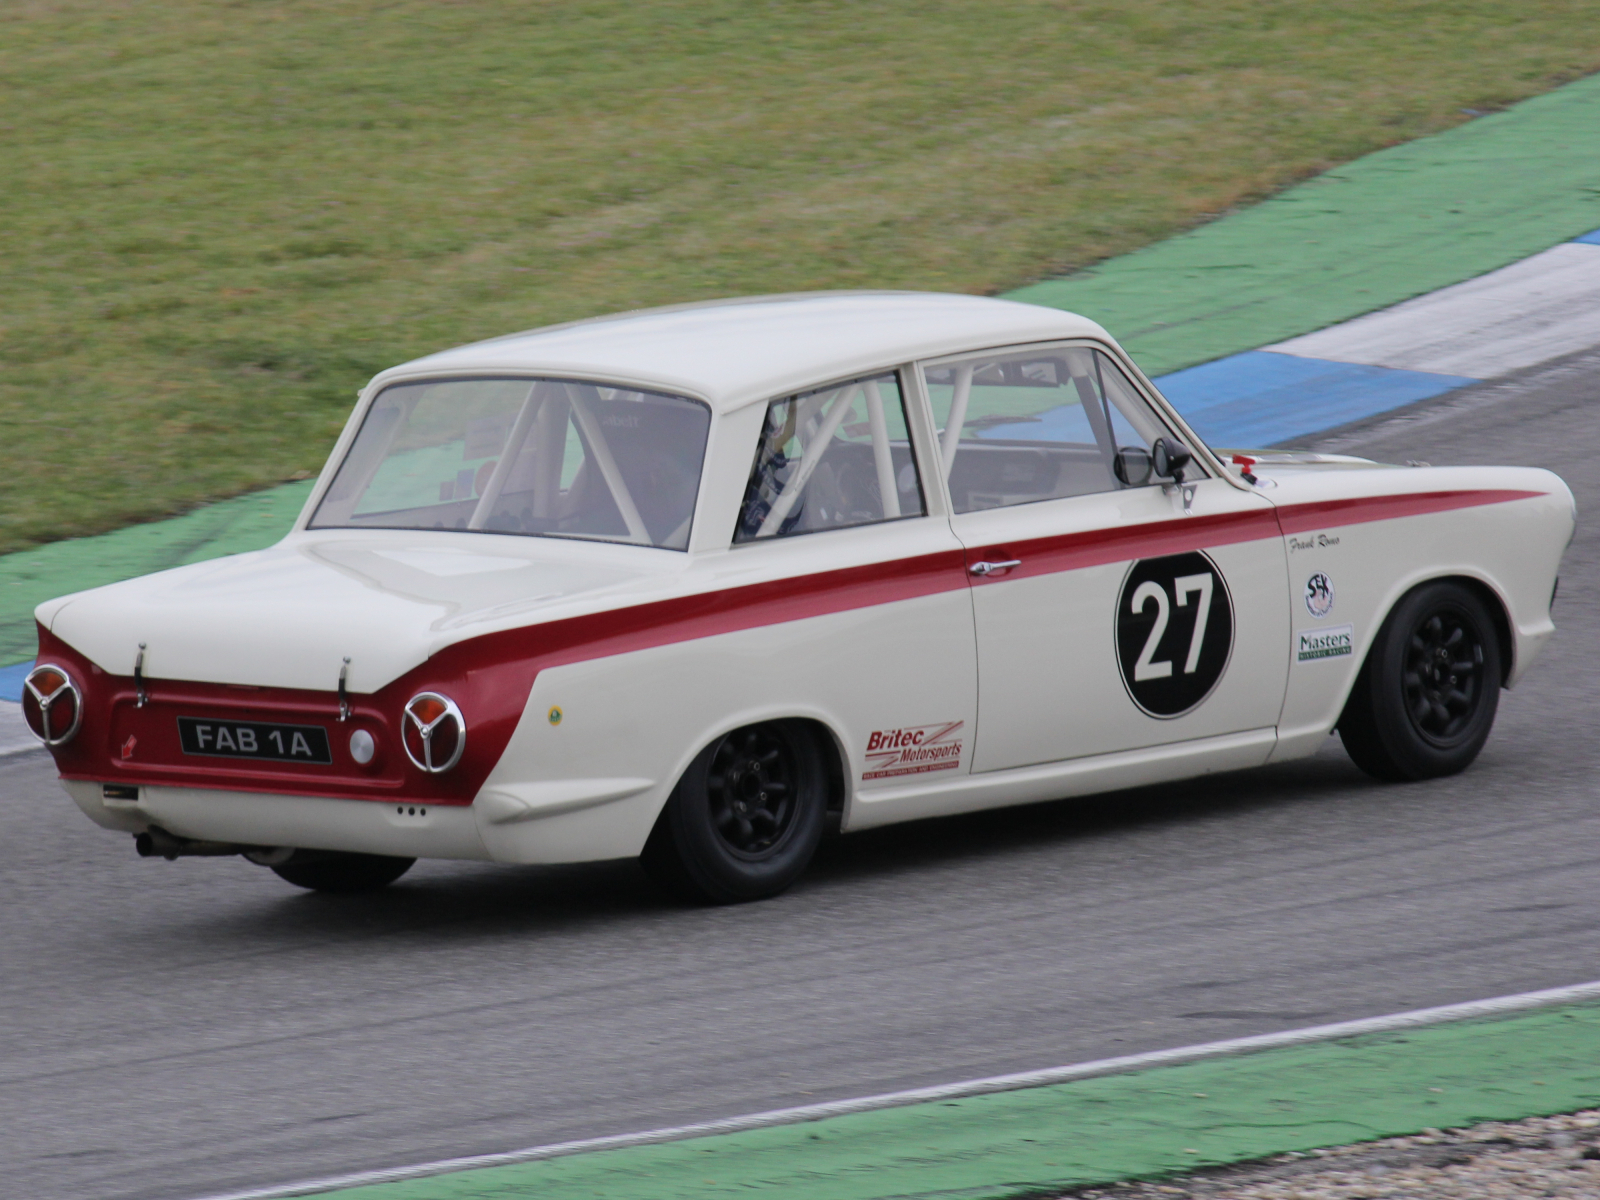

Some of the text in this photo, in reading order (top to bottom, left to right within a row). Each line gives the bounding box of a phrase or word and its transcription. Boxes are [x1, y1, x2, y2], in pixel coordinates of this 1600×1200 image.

[1131, 572, 1214, 682] 27
[1300, 633, 1351, 651] Masters
[195, 724, 312, 757] FAB 1A
[866, 729, 924, 751] Britec
[900, 742, 962, 763] Motorsports
